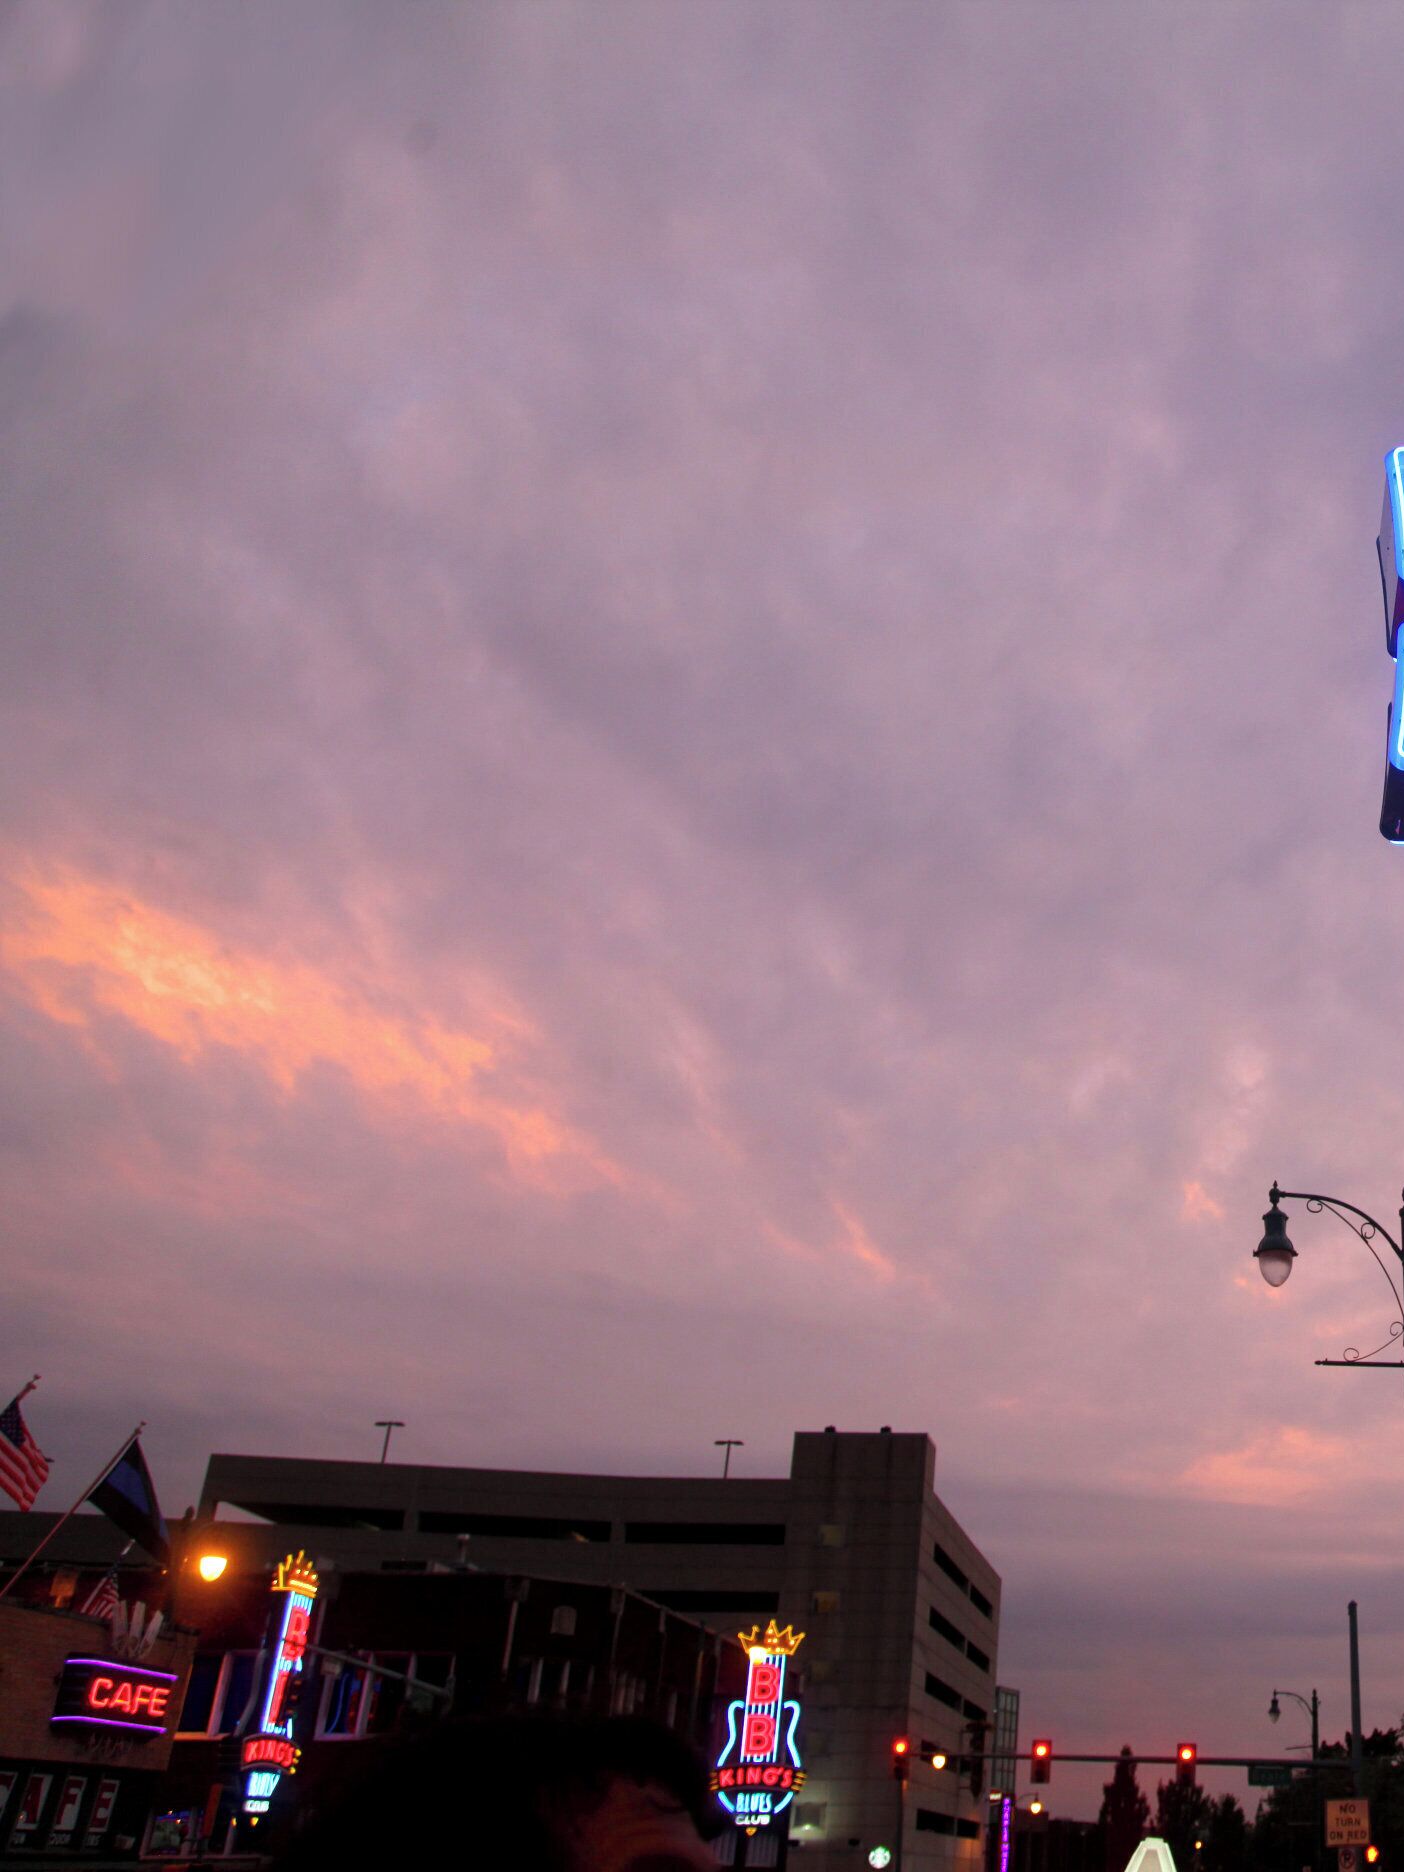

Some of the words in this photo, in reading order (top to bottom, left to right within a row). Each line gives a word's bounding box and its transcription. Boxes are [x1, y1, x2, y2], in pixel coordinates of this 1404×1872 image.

[748, 1664, 780, 1705] B
[88, 1676, 171, 1718] CAFE
[744, 1713, 776, 1757] B
[244, 1739, 296, 1769] KING'S
[718, 1766, 794, 1789] KING'S
[735, 1792, 773, 1814] BLUES
[1339, 1803, 1356, 1814] NO
[734, 1814, 771, 1826] CLUB
[1335, 1817, 1361, 1827] TURN
[1329, 1831, 1343, 1840] ON
[1347, 1830, 1367, 1840] RED
